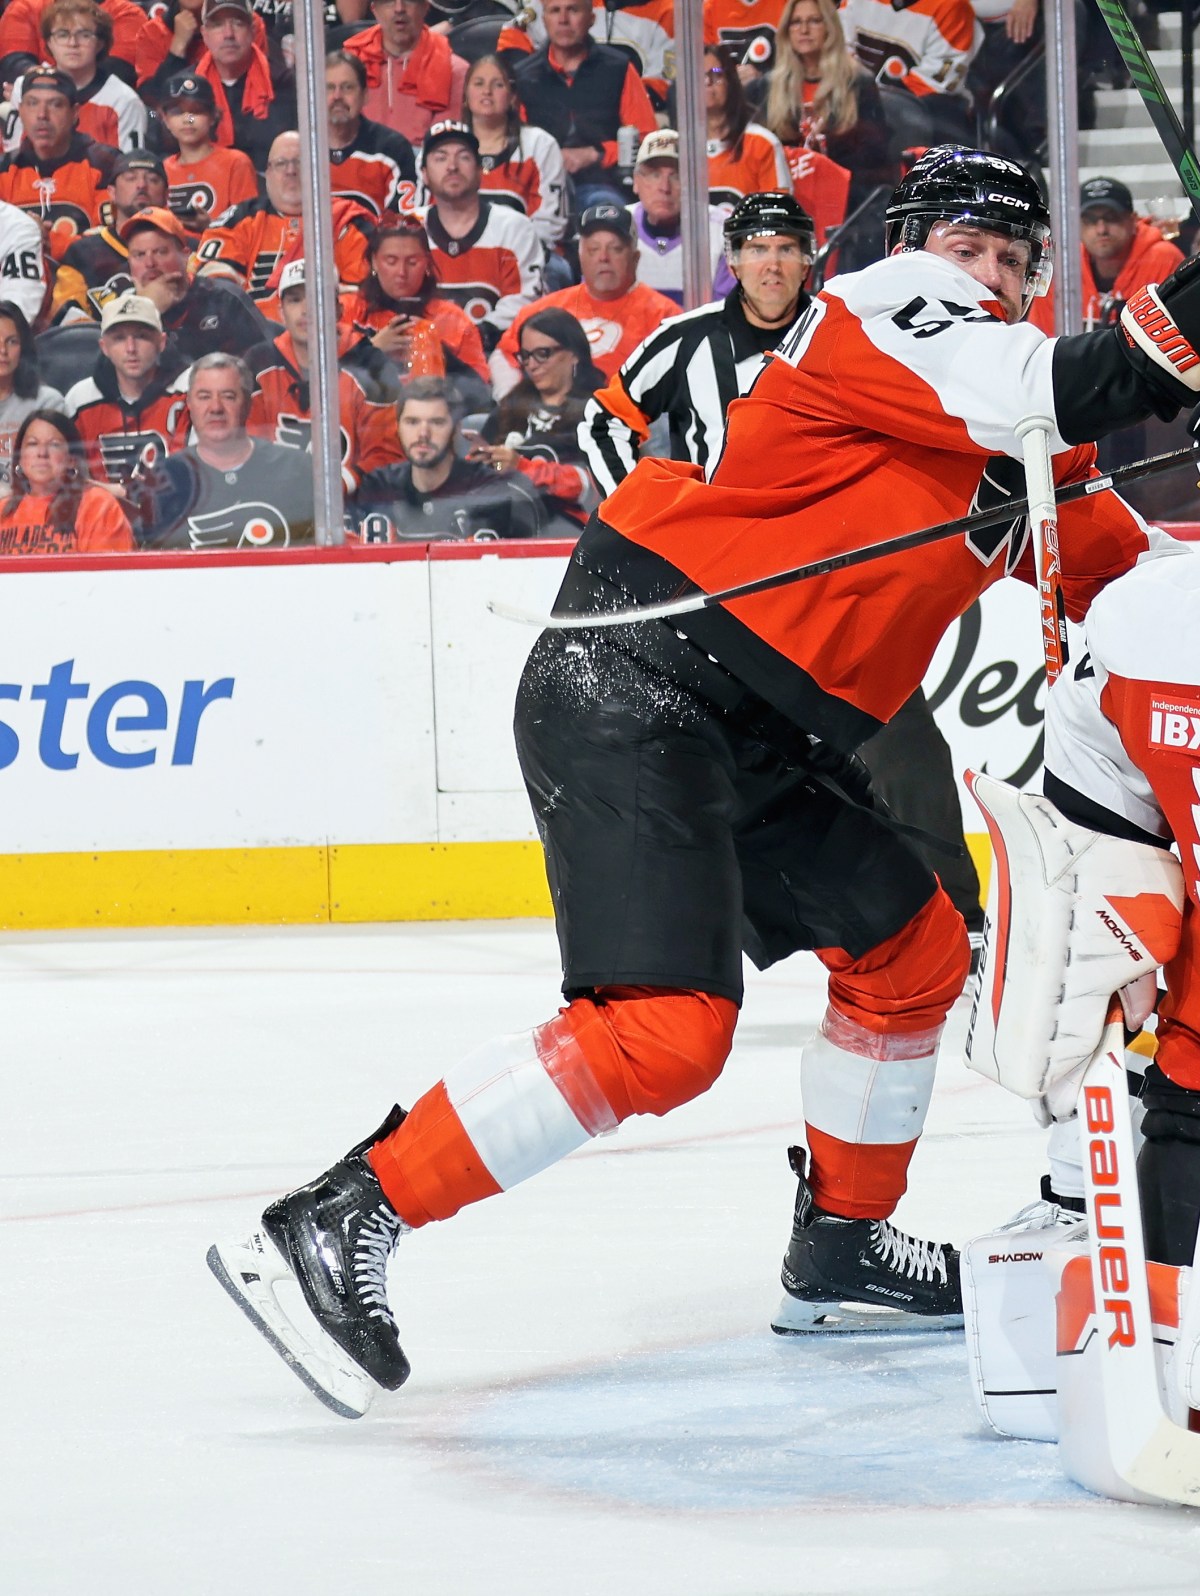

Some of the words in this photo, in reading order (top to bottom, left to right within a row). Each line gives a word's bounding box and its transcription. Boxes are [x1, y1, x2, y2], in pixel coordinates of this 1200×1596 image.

[988, 193, 1031, 211] CCM
[1, 251, 41, 281] 46
[1038, 580, 1061, 686] FLYLIT
[1096, 910, 1143, 962] SHADOW
[1084, 1085, 1136, 1351] BAUER
[988, 1251, 1043, 1264] SHADOW
[865, 1283, 914, 1302] BAUER
